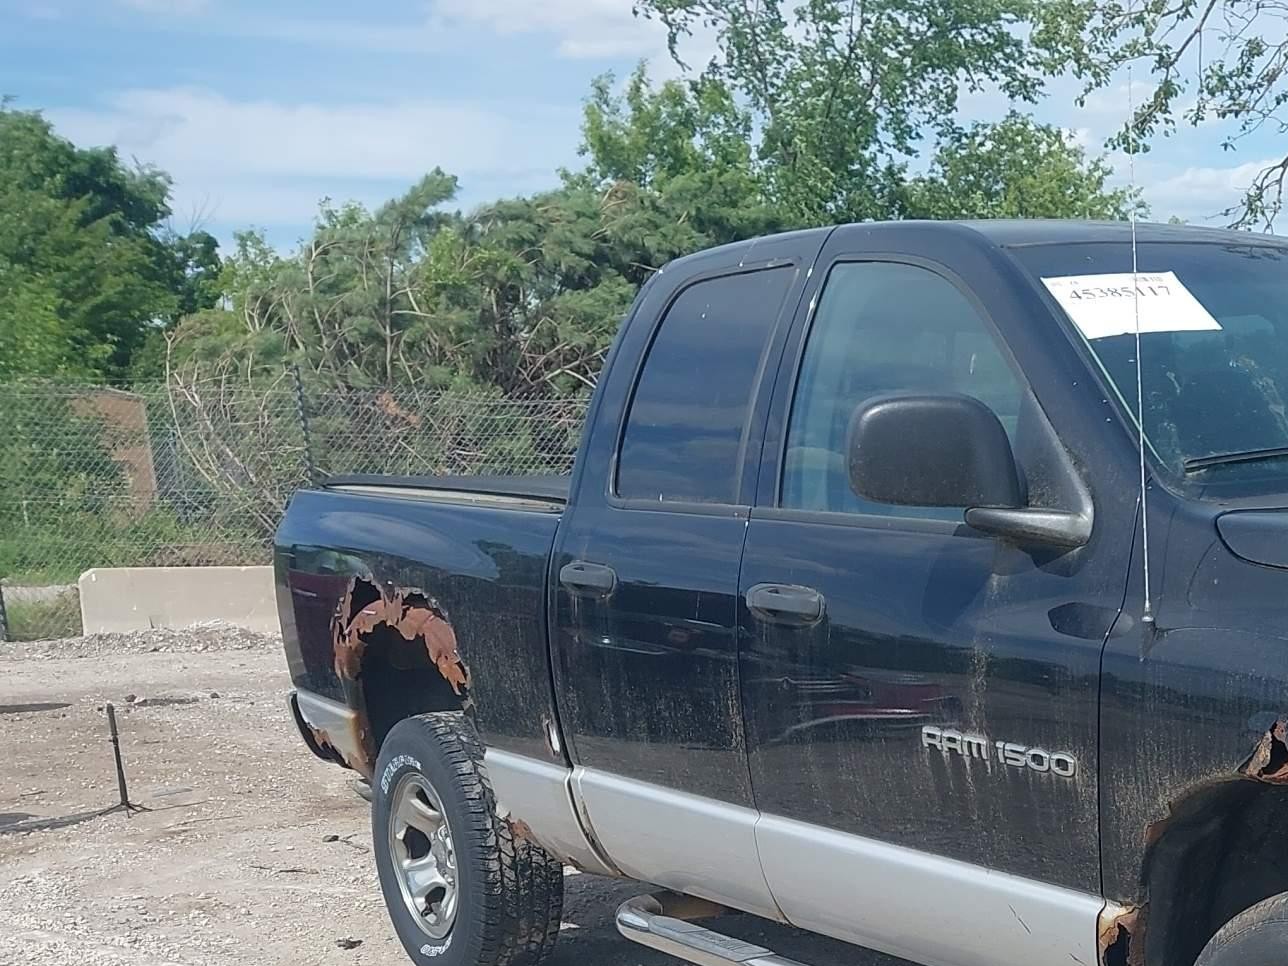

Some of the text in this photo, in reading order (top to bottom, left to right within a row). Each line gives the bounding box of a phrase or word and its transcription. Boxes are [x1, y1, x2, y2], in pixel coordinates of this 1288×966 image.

[1070, 285, 1171, 300] 45385117
[922, 726, 1077, 777] RAM 1500
